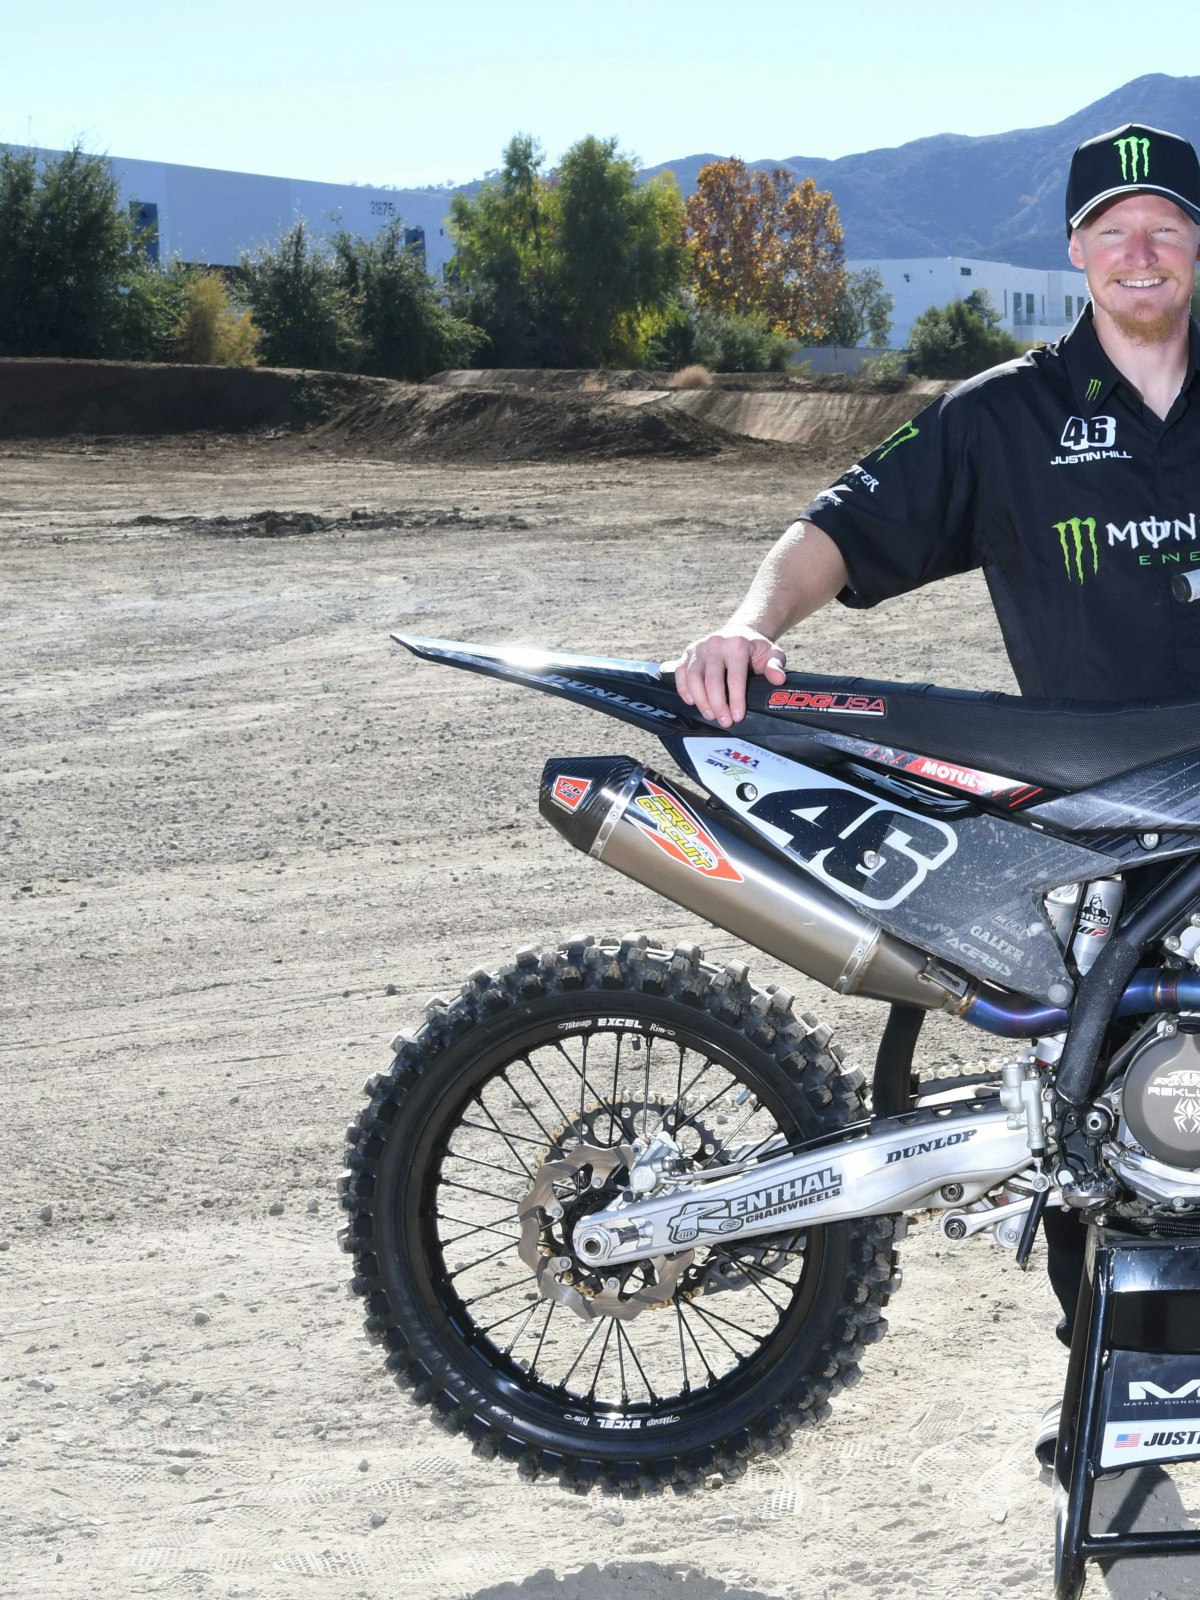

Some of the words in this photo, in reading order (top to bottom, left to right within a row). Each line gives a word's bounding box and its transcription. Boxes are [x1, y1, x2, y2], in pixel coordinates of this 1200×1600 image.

[1060, 415, 1117, 450] 46
[1050, 451, 1100, 465] JUSTIN
[1102, 450, 1133, 459] HILL
[842, 475, 861, 486] RGY
[846, 464, 880, 493] STER
[548, 674, 678, 720] DUNLOP
[920, 760, 977, 789] MOTUL
[652, 795, 698, 835] PRO
[637, 797, 713, 869] CIRCUIT
[746, 786, 958, 910] 46
[597, 1017, 643, 1029] EXCEL
[649, 1023, 676, 1037] Rim
[885, 1129, 977, 1164] DUNLOP
[667, 1166, 842, 1244] RENTHAL
[745, 1187, 841, 1225] CHAINWHEELS
[563, 1413, 590, 1427] Rim
[596, 1418, 641, 1429] EXCEL
